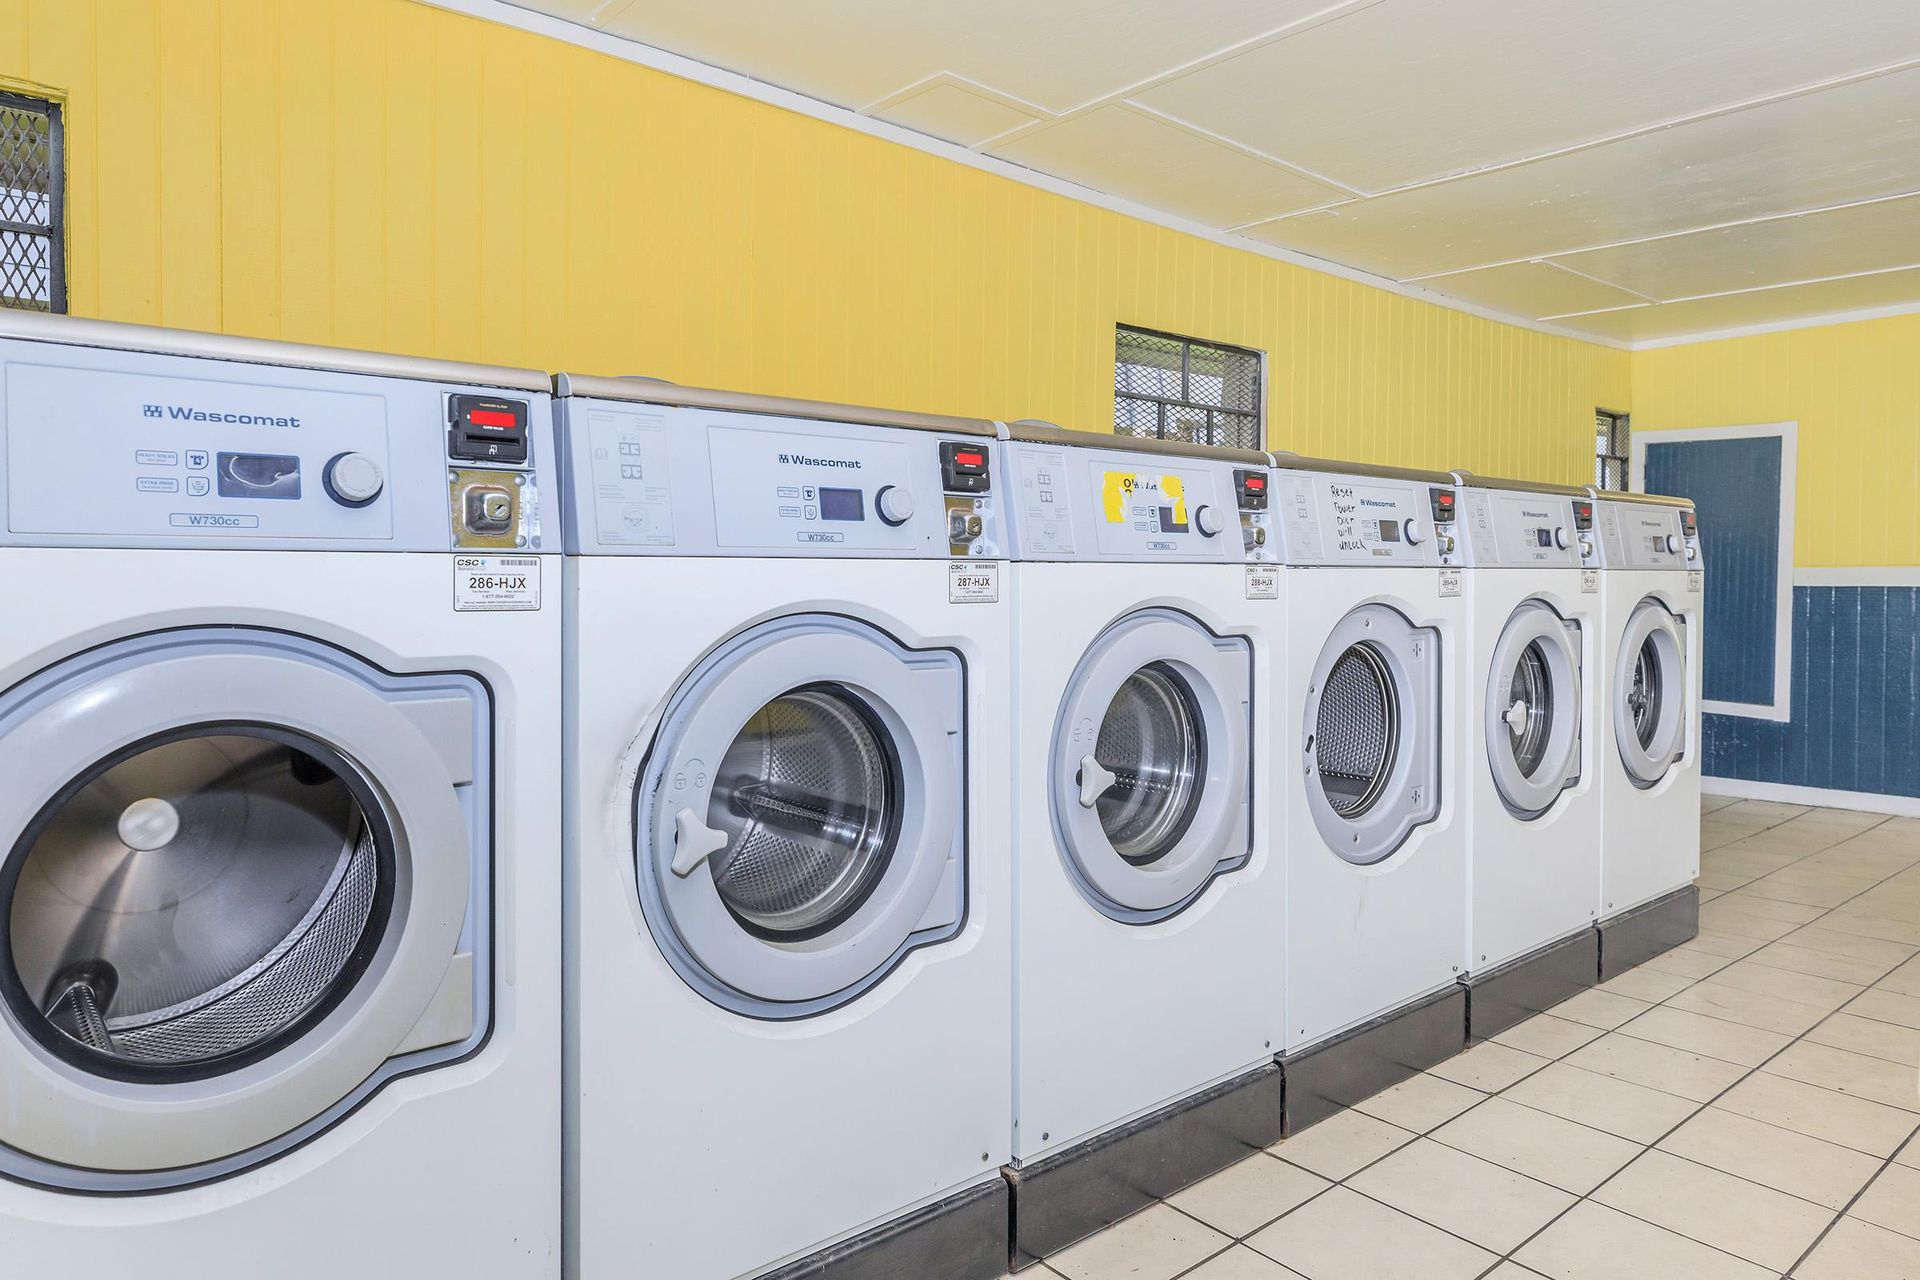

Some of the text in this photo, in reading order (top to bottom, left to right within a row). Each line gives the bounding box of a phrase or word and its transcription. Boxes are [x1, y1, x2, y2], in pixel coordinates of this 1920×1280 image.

[168, 406, 301, 428] Wascomat
[790, 454, 862, 469] Wascomat
[1330, 484, 1353, 499] Reset
[1365, 499, 1396, 508] Wascomat
[189, 515, 240, 526] W730cc
[807, 533, 835, 542] W730cc
[469, 577, 527, 589] 286-HJX
[957, 577, 991, 587] 287-HJX
